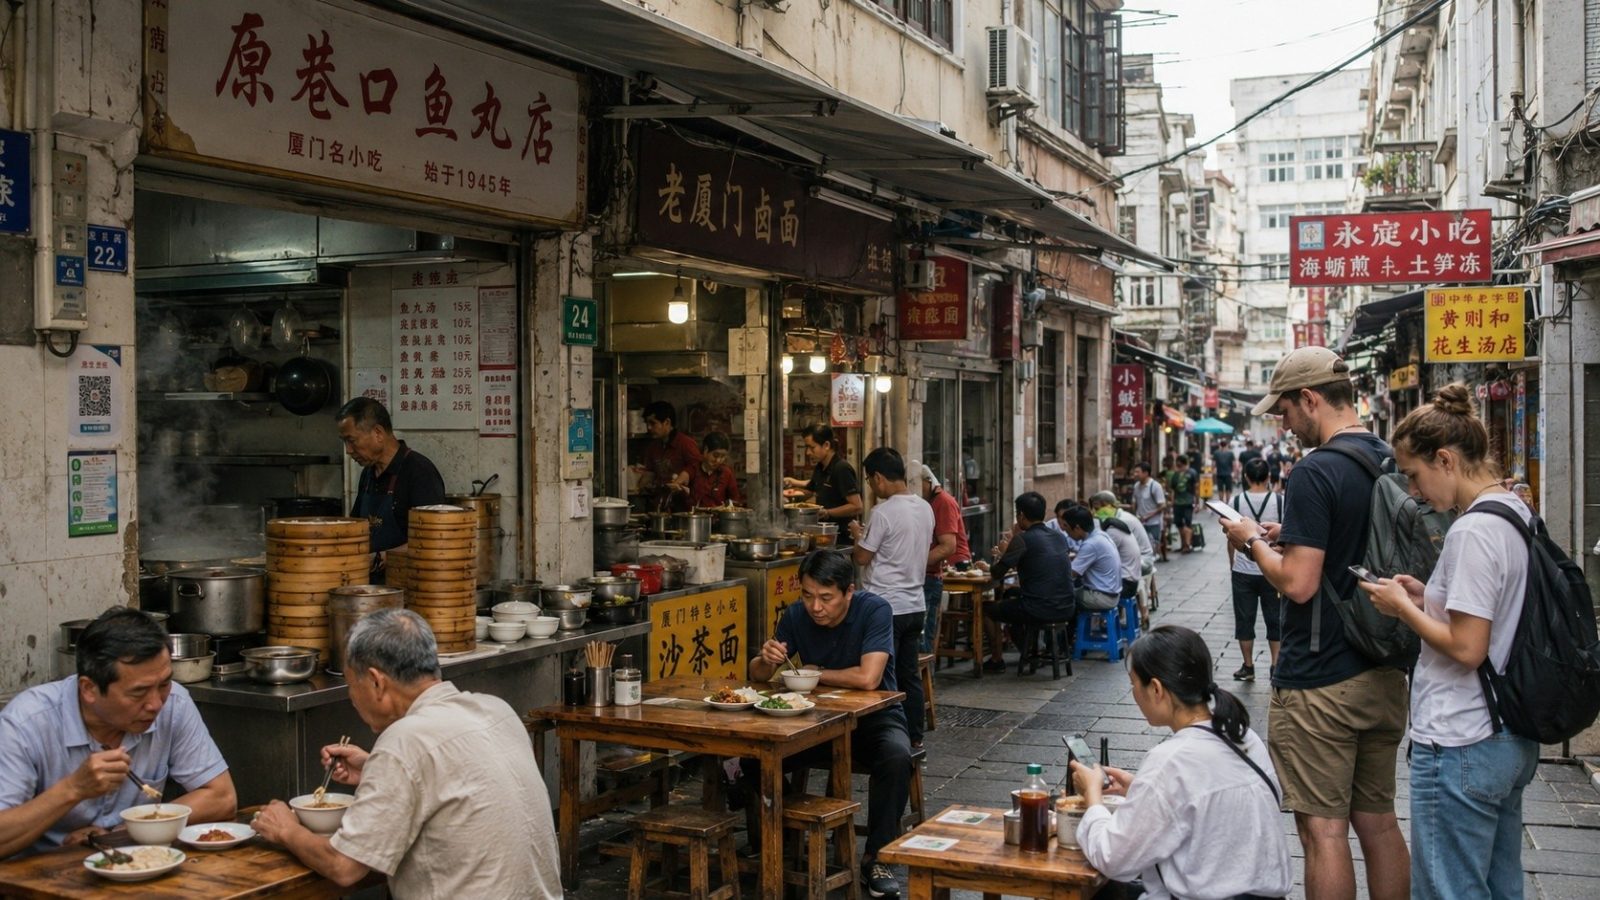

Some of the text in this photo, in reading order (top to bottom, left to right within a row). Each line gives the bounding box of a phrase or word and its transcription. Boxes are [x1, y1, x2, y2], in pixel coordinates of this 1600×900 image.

[215, 12, 554, 166] 原巷口鱼丸店
[287, 131, 511, 197] 厦门名小吃 始于1945年
[658, 162, 799, 248] 老厦门卤面
[94, 245, 115, 266] 22
[572, 304, 589, 328] 24
[1440, 308, 1510, 329] 黄则和
[1432, 334, 1517, 355] 花生汤店
[659, 623, 739, 679] 沙茶面
